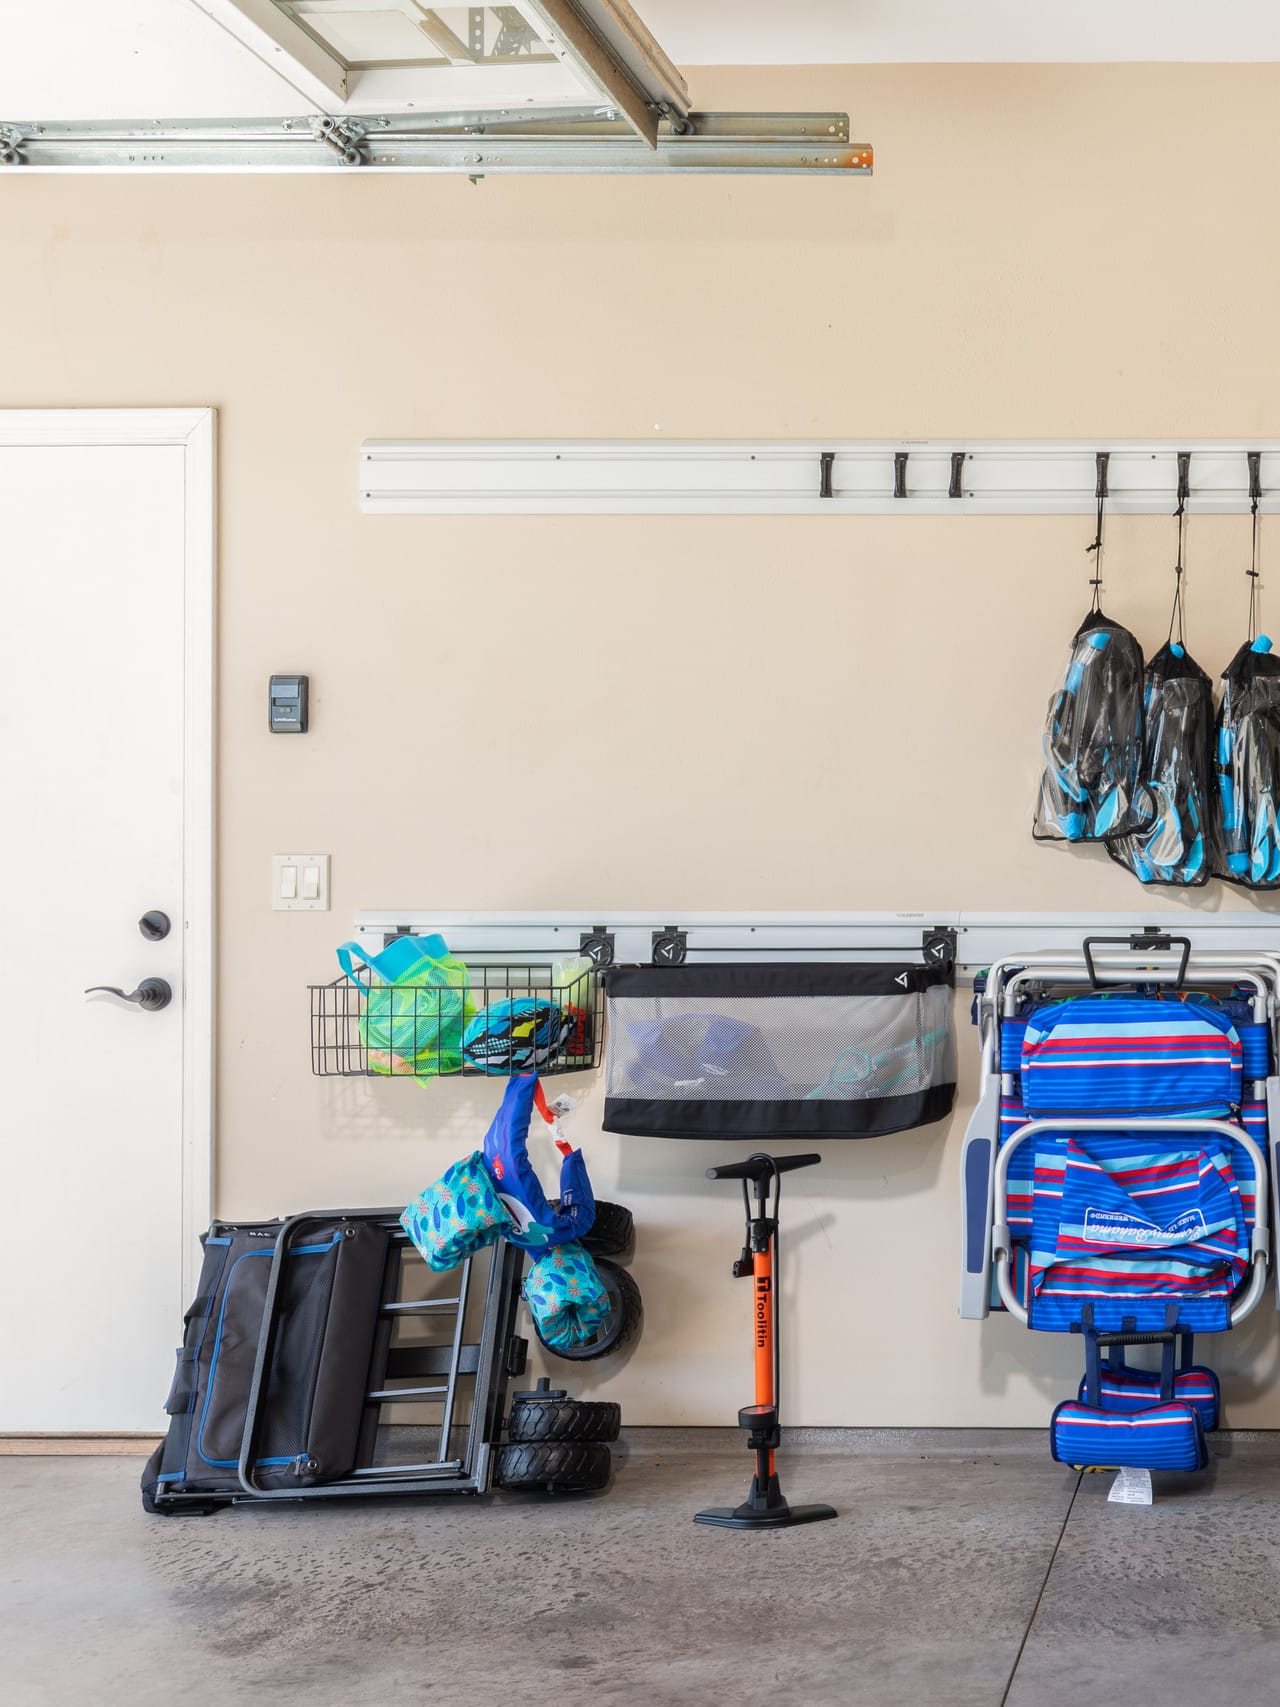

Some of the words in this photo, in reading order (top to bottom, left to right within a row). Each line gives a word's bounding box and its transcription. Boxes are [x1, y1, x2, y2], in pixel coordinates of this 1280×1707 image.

[1089, 1225, 1152, 1243] Bahama
[1150, 1225, 1202, 1242] Tommy
[756, 1292, 768, 1348] Toolitin
